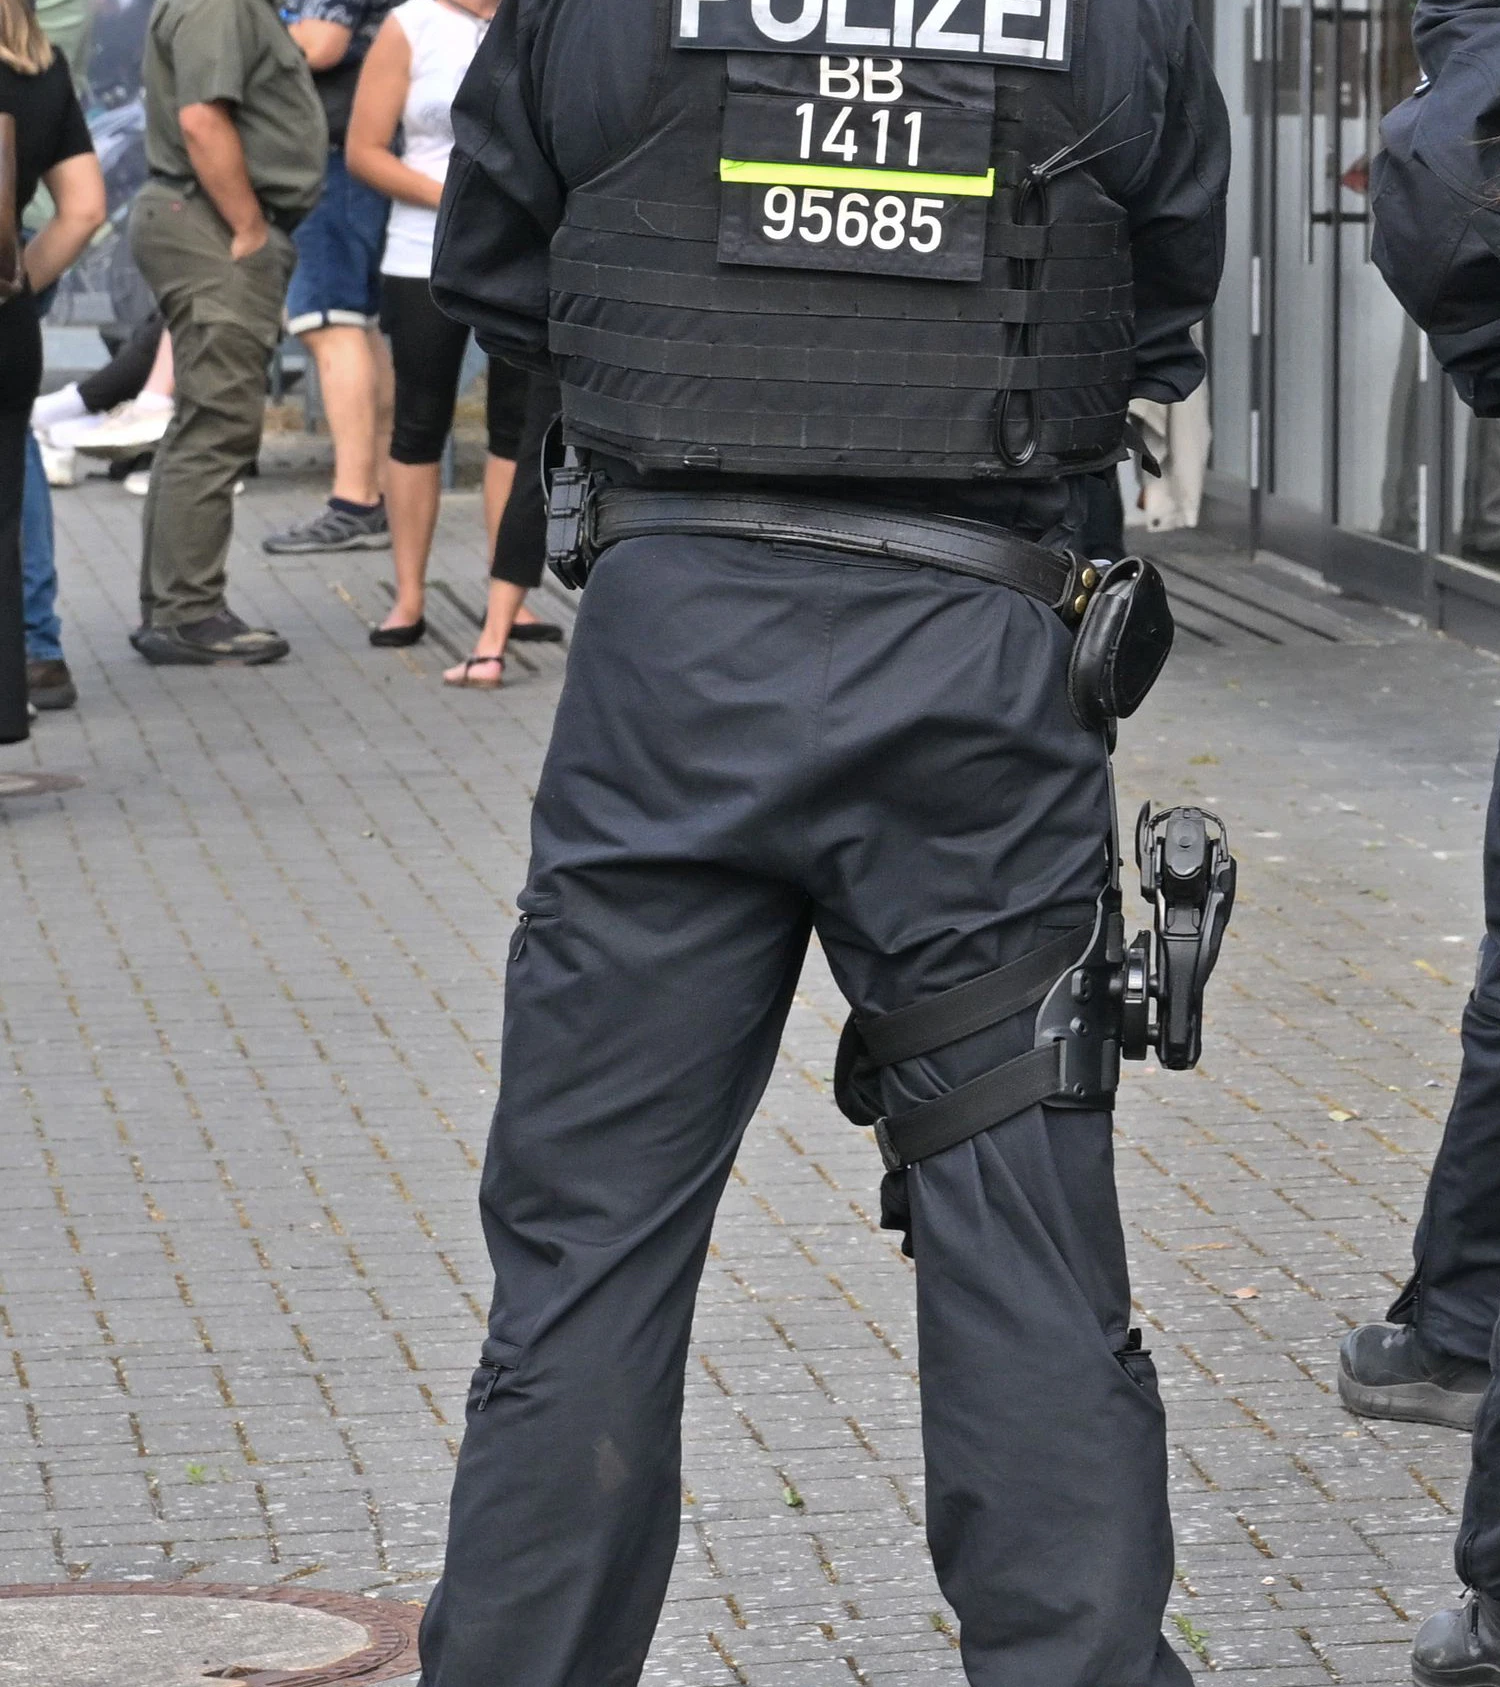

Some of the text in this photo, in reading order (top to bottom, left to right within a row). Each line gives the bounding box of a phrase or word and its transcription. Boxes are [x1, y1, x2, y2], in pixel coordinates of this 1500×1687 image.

[819, 55, 904, 103] BB
[795, 102, 923, 167] 1411
[762, 185, 945, 253] 95685
